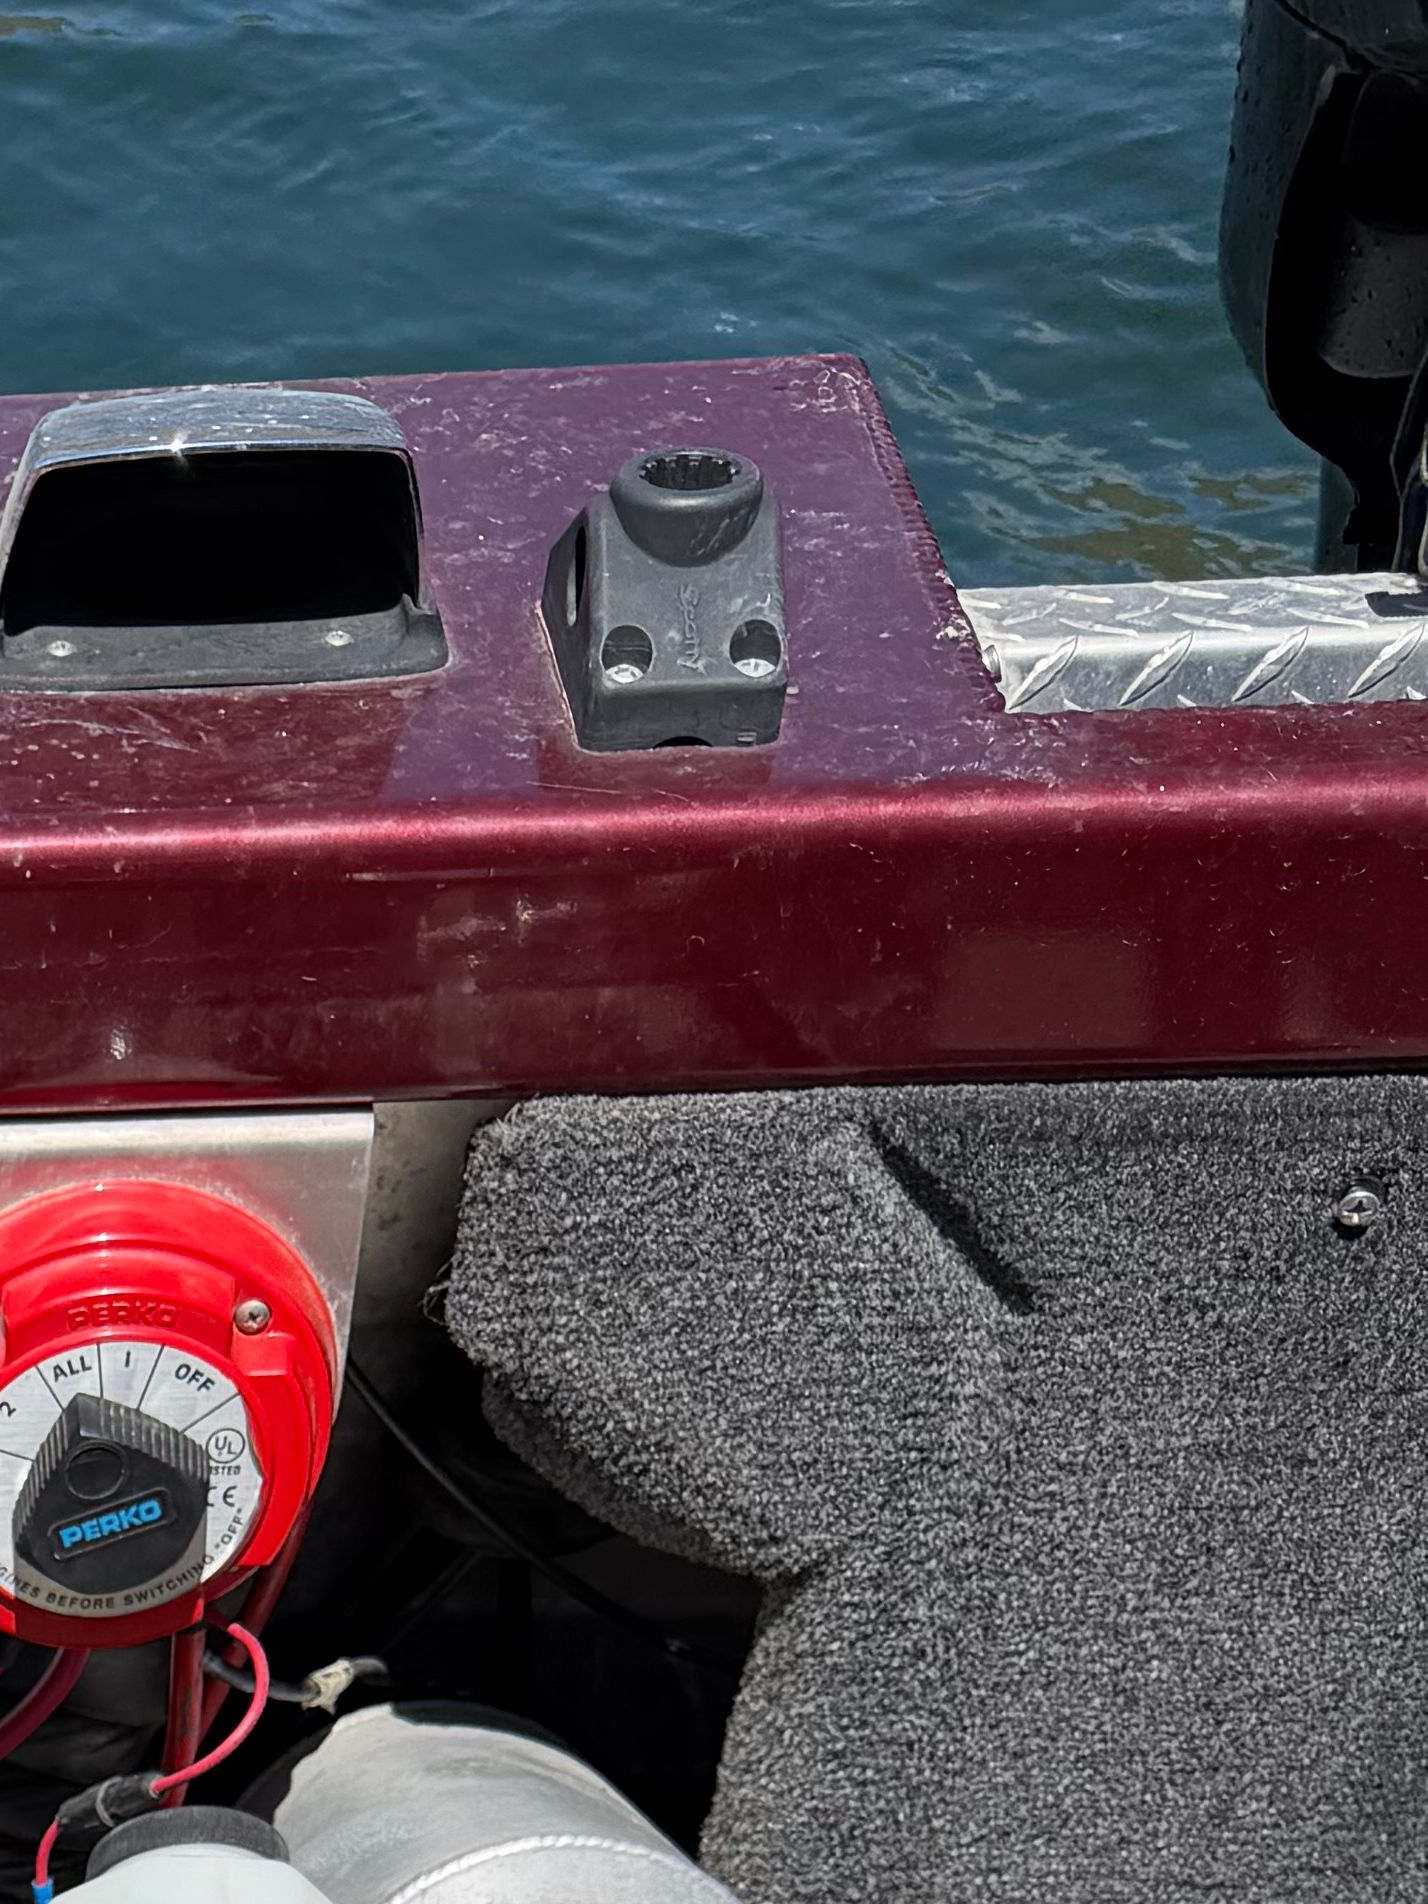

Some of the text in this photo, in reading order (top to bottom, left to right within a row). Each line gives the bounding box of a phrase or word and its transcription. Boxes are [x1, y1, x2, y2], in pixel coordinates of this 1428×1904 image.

[67, 1300, 178, 1332] PERKO
[52, 1355, 93, 1383] ALL
[174, 1363, 216, 1393] OFF
[209, 1465, 241, 1476] ISTED
[58, 1498, 163, 1549] PERKO
[46, 1591, 116, 1610] BEFORE
[123, 1554, 215, 1606] SWITCHING
